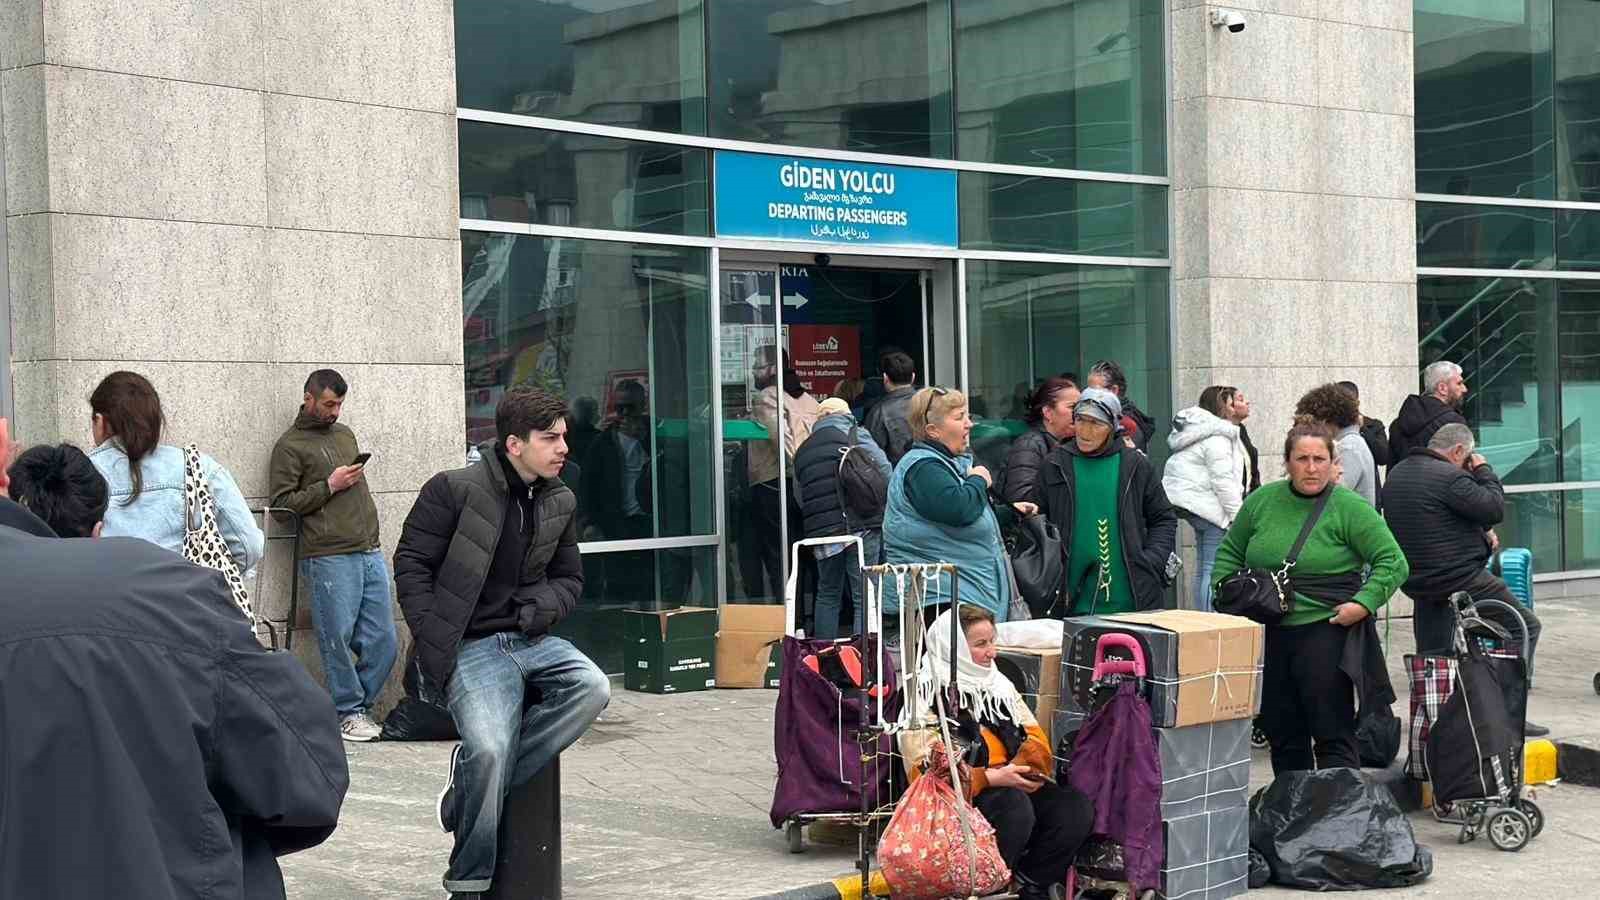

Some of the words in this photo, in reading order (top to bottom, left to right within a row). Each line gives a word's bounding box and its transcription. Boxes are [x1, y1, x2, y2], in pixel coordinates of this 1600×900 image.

[780, 161, 835, 191] GİDEN
[840, 170, 894, 194] YOLCU
[768, 203, 834, 222] DEPARTING
[837, 209, 907, 226] PASSENGERS
